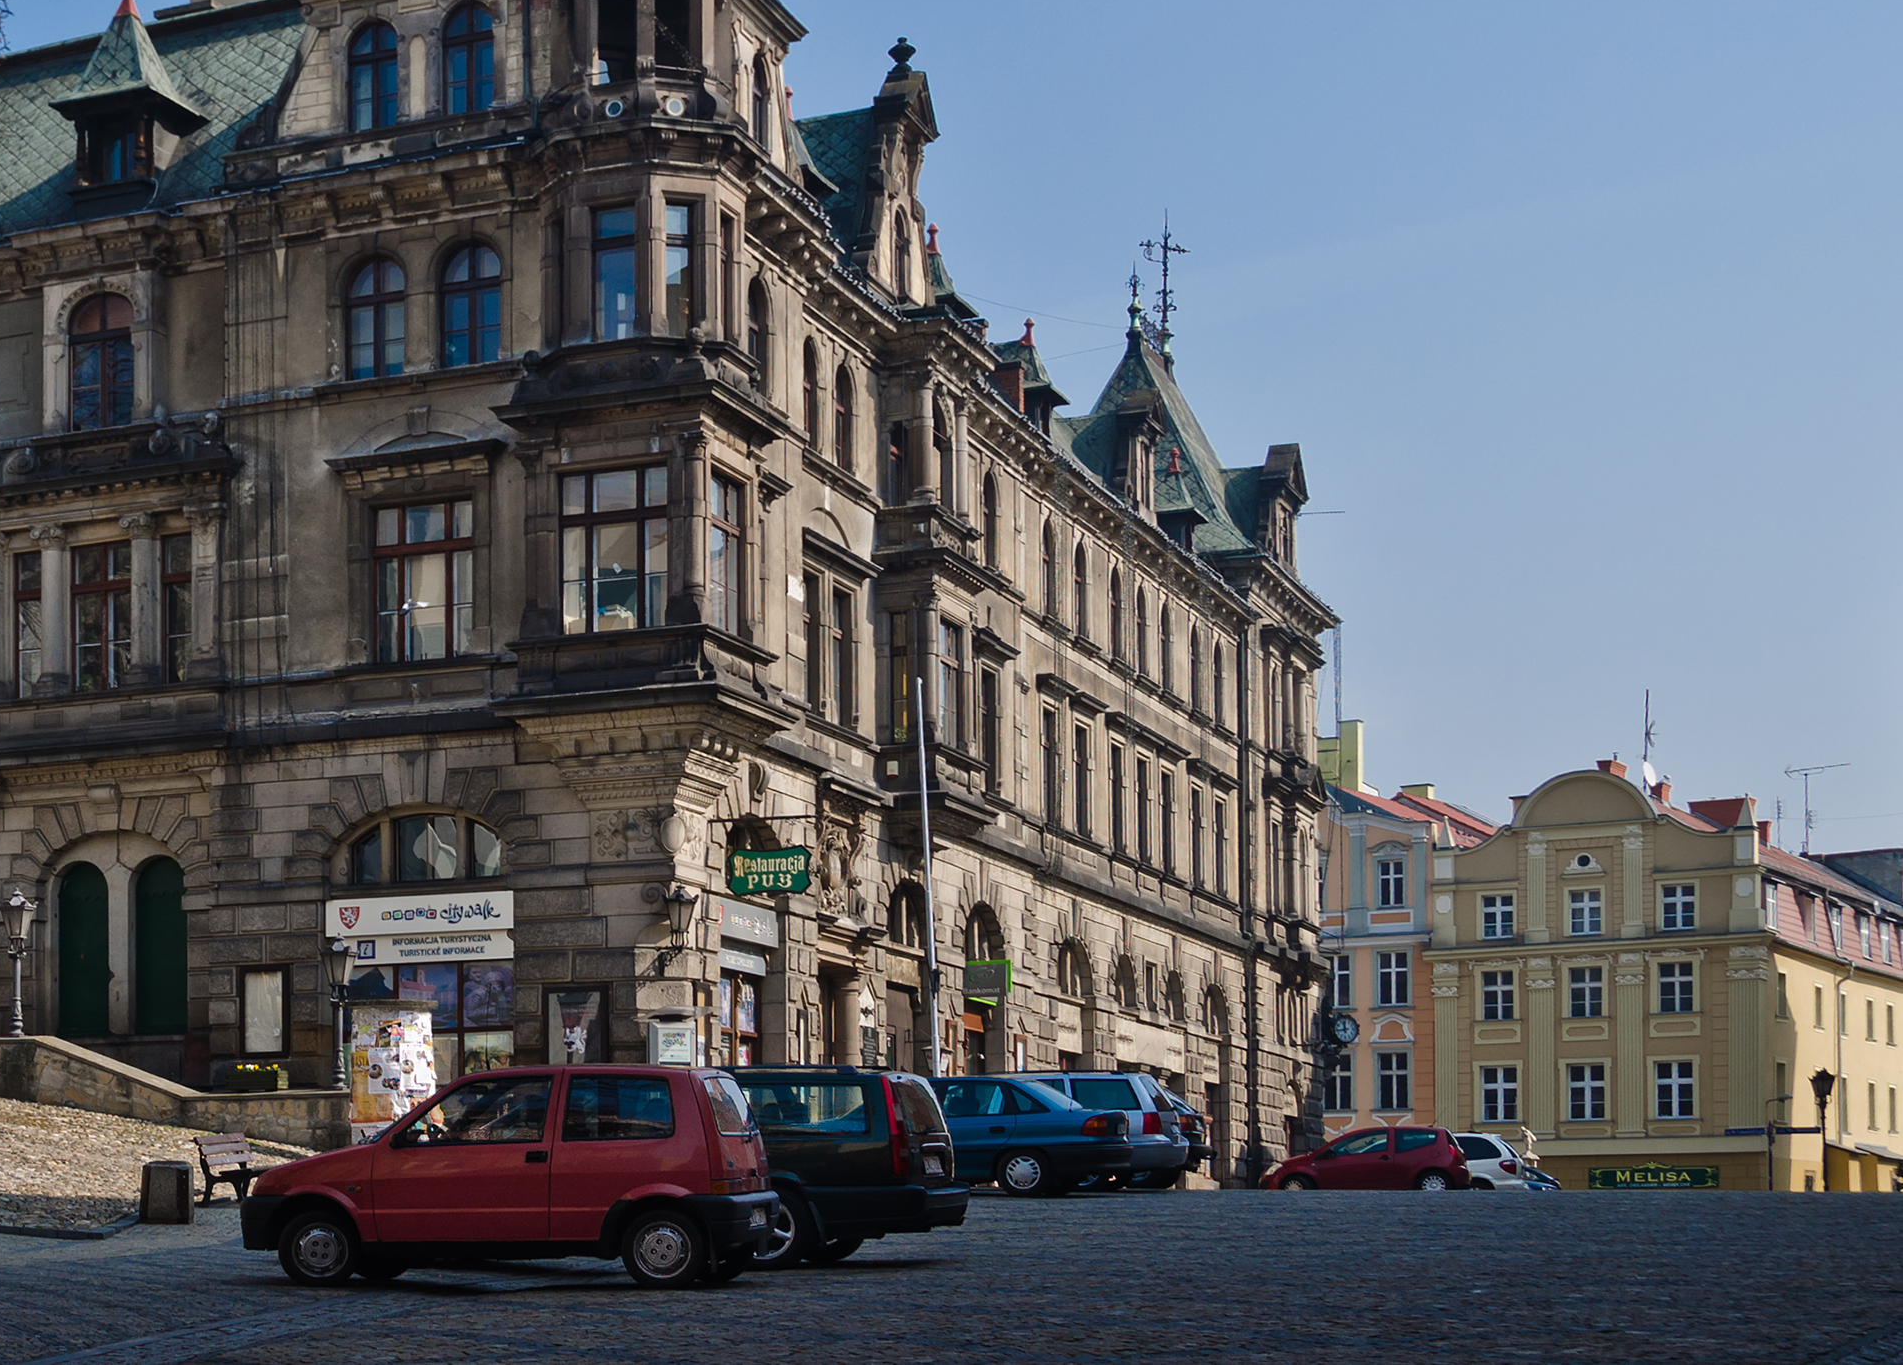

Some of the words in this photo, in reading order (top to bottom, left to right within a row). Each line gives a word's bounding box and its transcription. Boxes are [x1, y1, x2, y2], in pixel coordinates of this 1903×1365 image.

[734, 854, 805, 878] Restauracja
[747, 873, 792, 890] PUB
[392, 936, 439, 946] INFORMACJA
[439, 934, 492, 944] TURYSTYCZNA
[399, 946, 441, 957] TURISTICKÉ
[442, 946, 485, 955] INFORMACE
[964, 987, 1001, 995] Bankomat
[1616, 1170, 1691, 1182] MELISA
